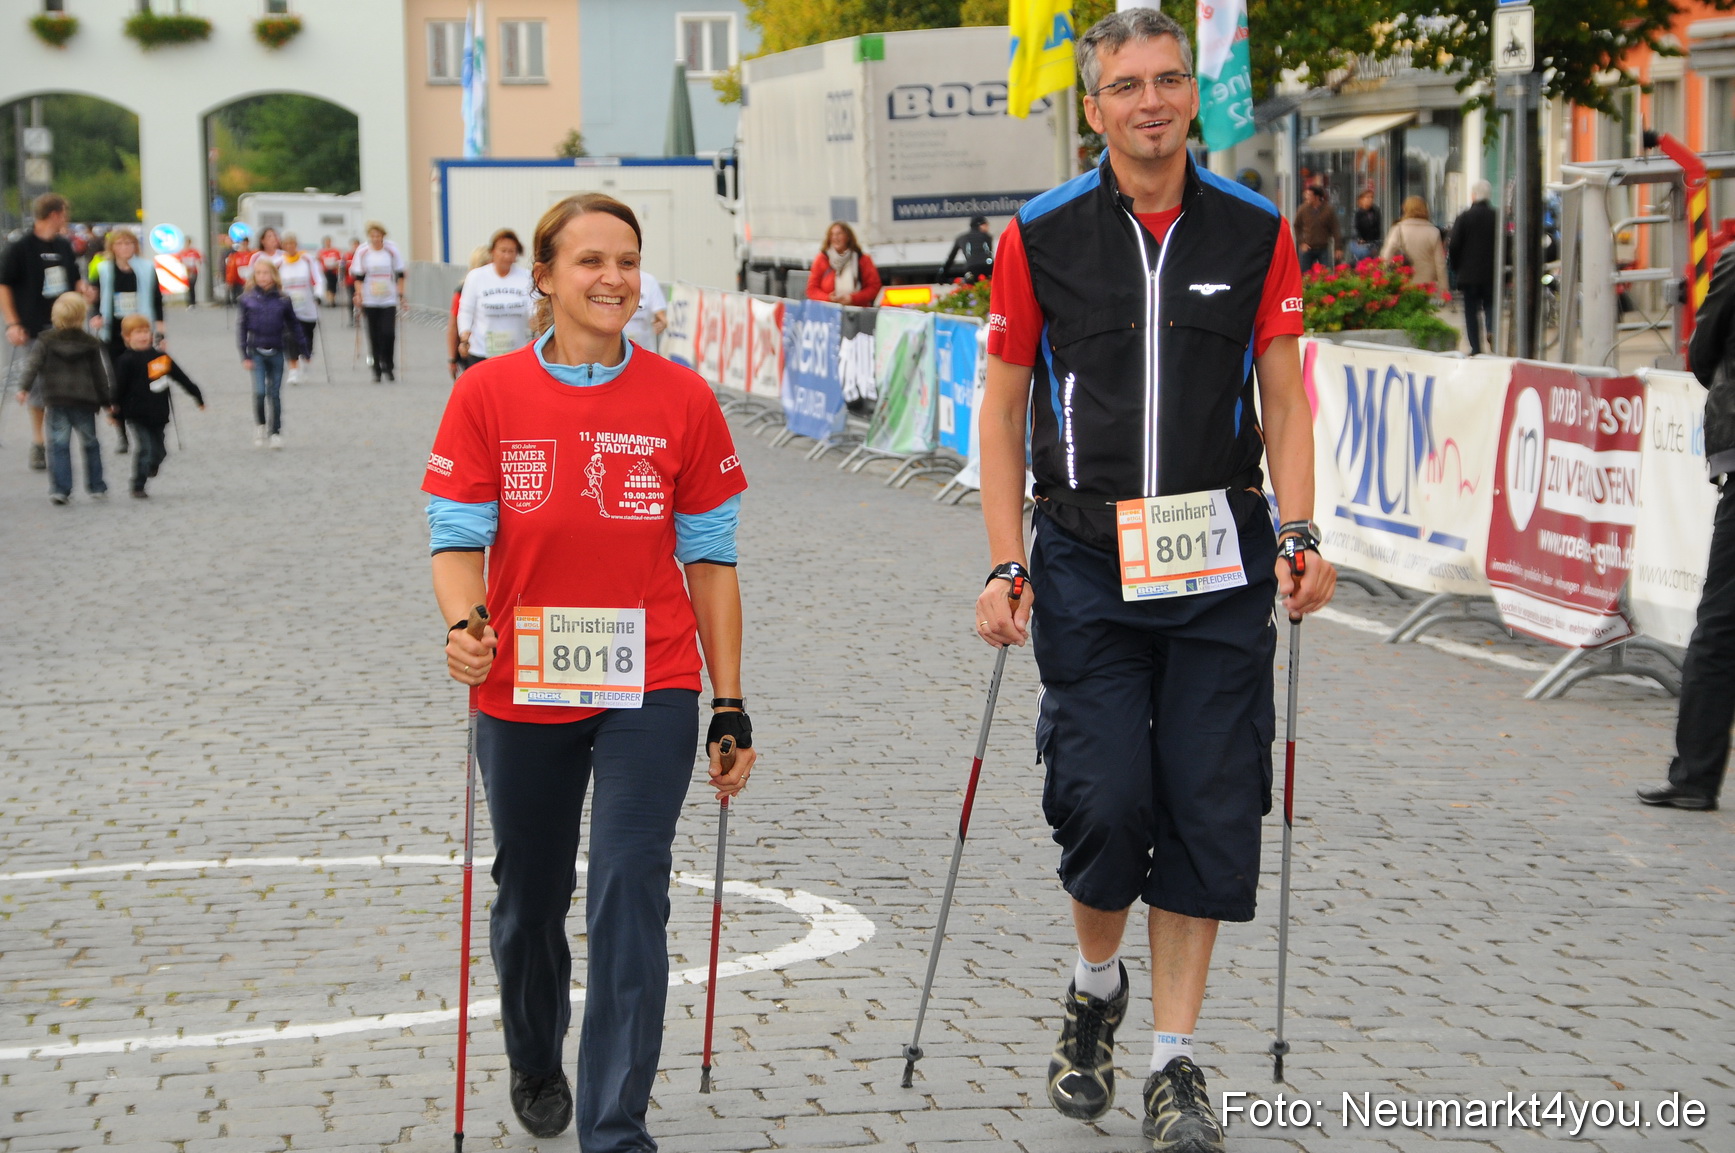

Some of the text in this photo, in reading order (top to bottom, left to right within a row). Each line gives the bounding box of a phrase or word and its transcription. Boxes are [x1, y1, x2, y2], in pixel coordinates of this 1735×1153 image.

[1653, 406, 1685, 453] Gute
[579, 431, 667, 449] 11. NEUMARKTER
[502, 450, 546, 461] IMMER
[594, 443, 654, 456] STADTLAUF
[500, 462, 548, 472] WIEDER
[503, 474, 544, 489] NEU
[504, 491, 543, 500] MARKT
[623, 491, 665, 500] 19.09.2010
[1151, 498, 1217, 524] Reinhard
[1156, 528, 1227, 563] 8017
[1137, 585, 1169, 594] BOCK
[1198, 572, 1243, 586] PFLEIDERER
[551, 614, 635, 634] Christiane
[552, 645, 633, 673] 8018
[528, 691, 641, 701] BOCK PFLEIDERER
[1158, 1034, 1177, 1044] TECH
